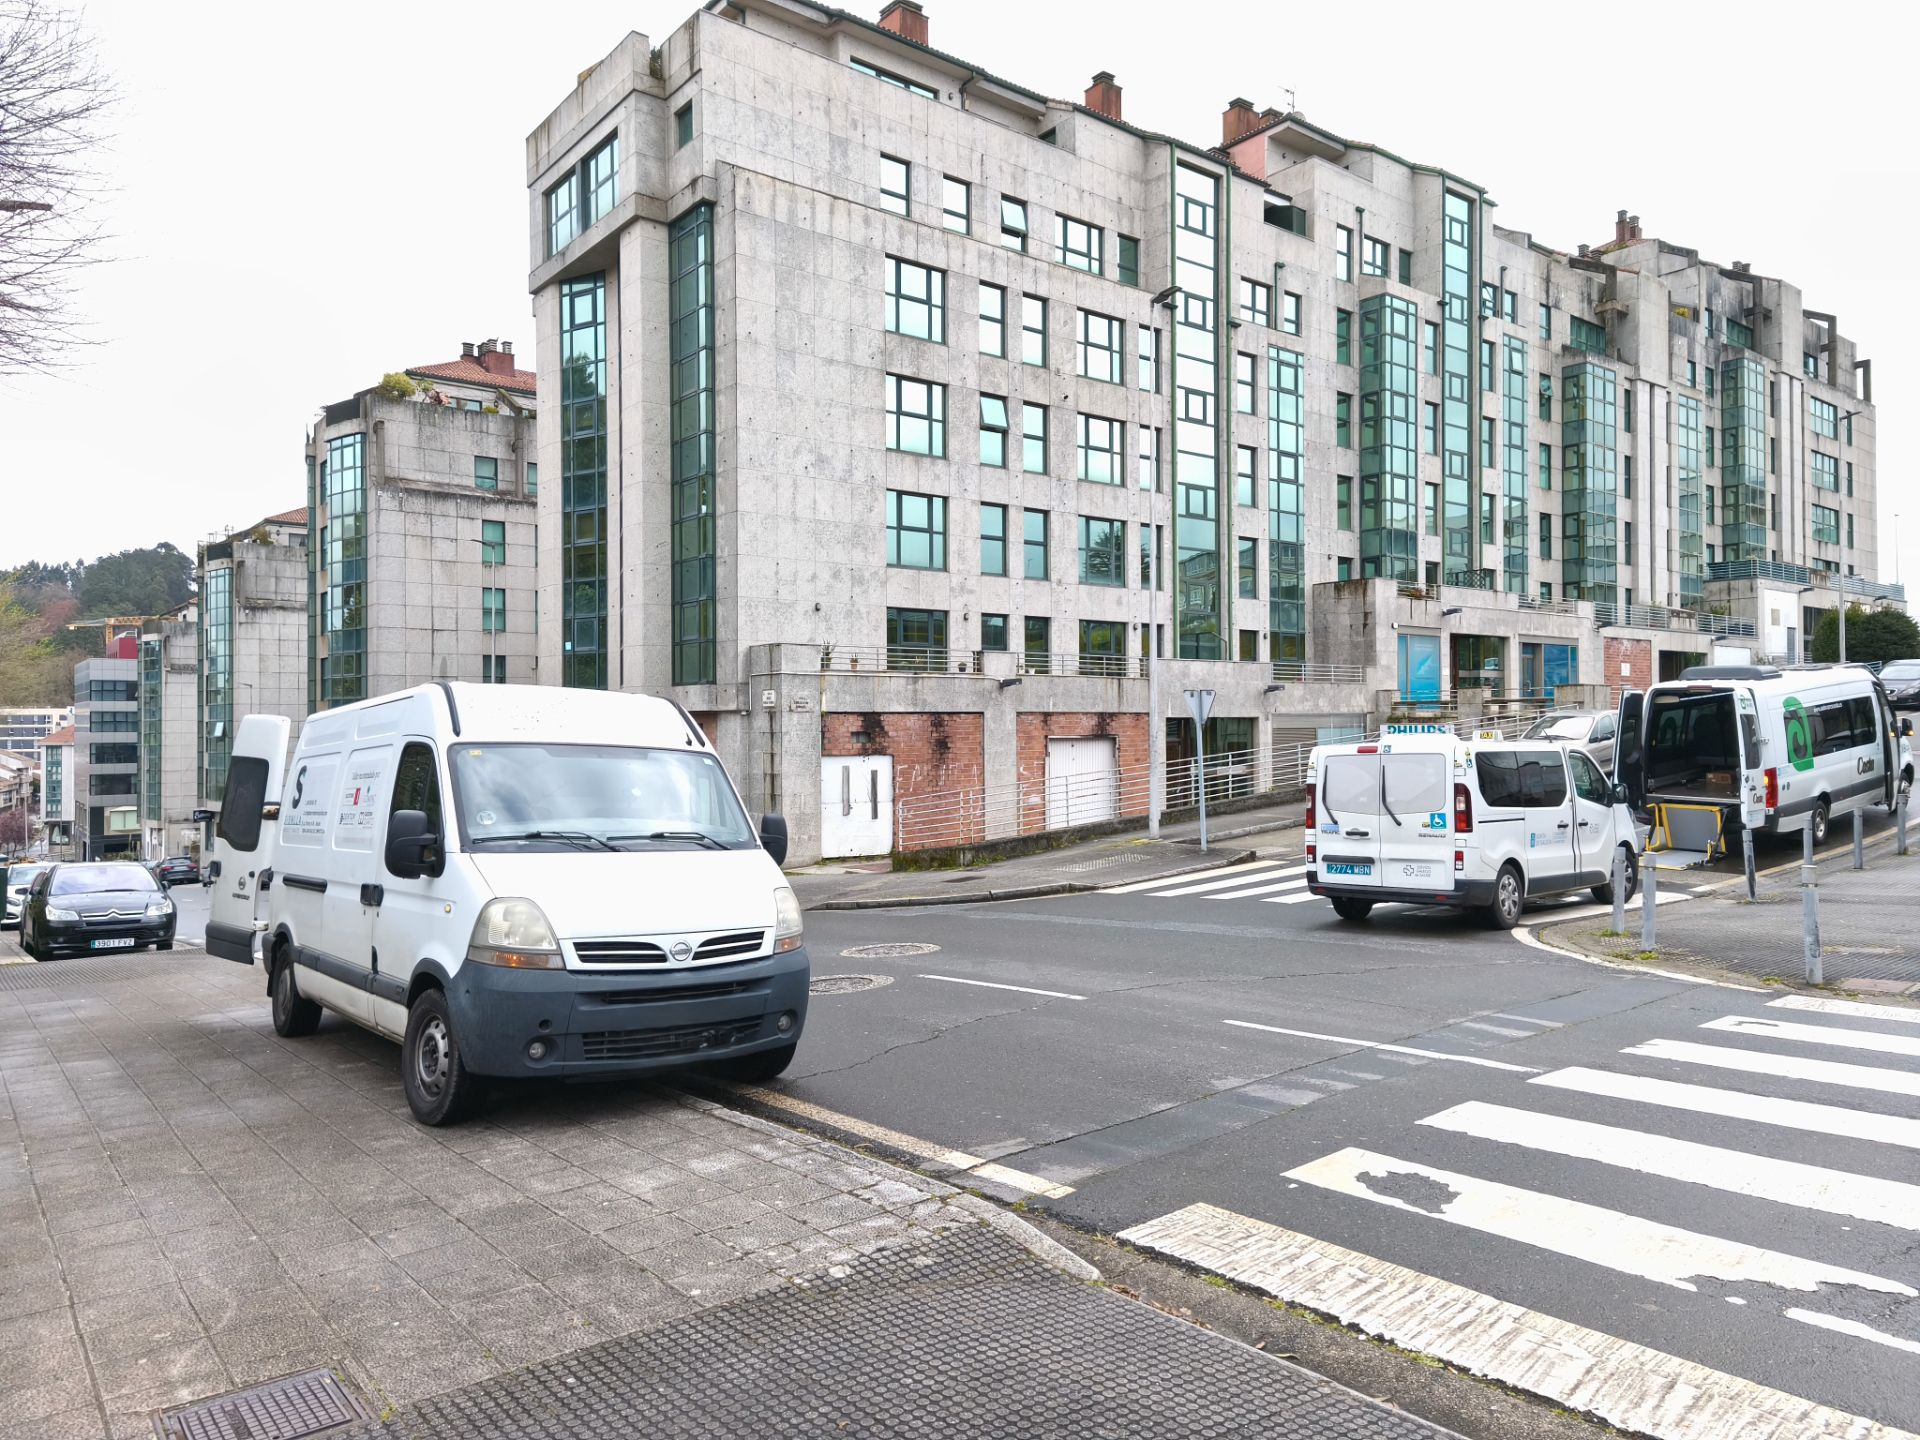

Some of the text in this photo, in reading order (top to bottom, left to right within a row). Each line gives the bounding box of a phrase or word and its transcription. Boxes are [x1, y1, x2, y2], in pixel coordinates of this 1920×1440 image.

[1387, 724, 1446, 734] PHILIPS
[1331, 864, 1352, 874] 2774
[96, 938, 132, 947] 3901 FVZ
